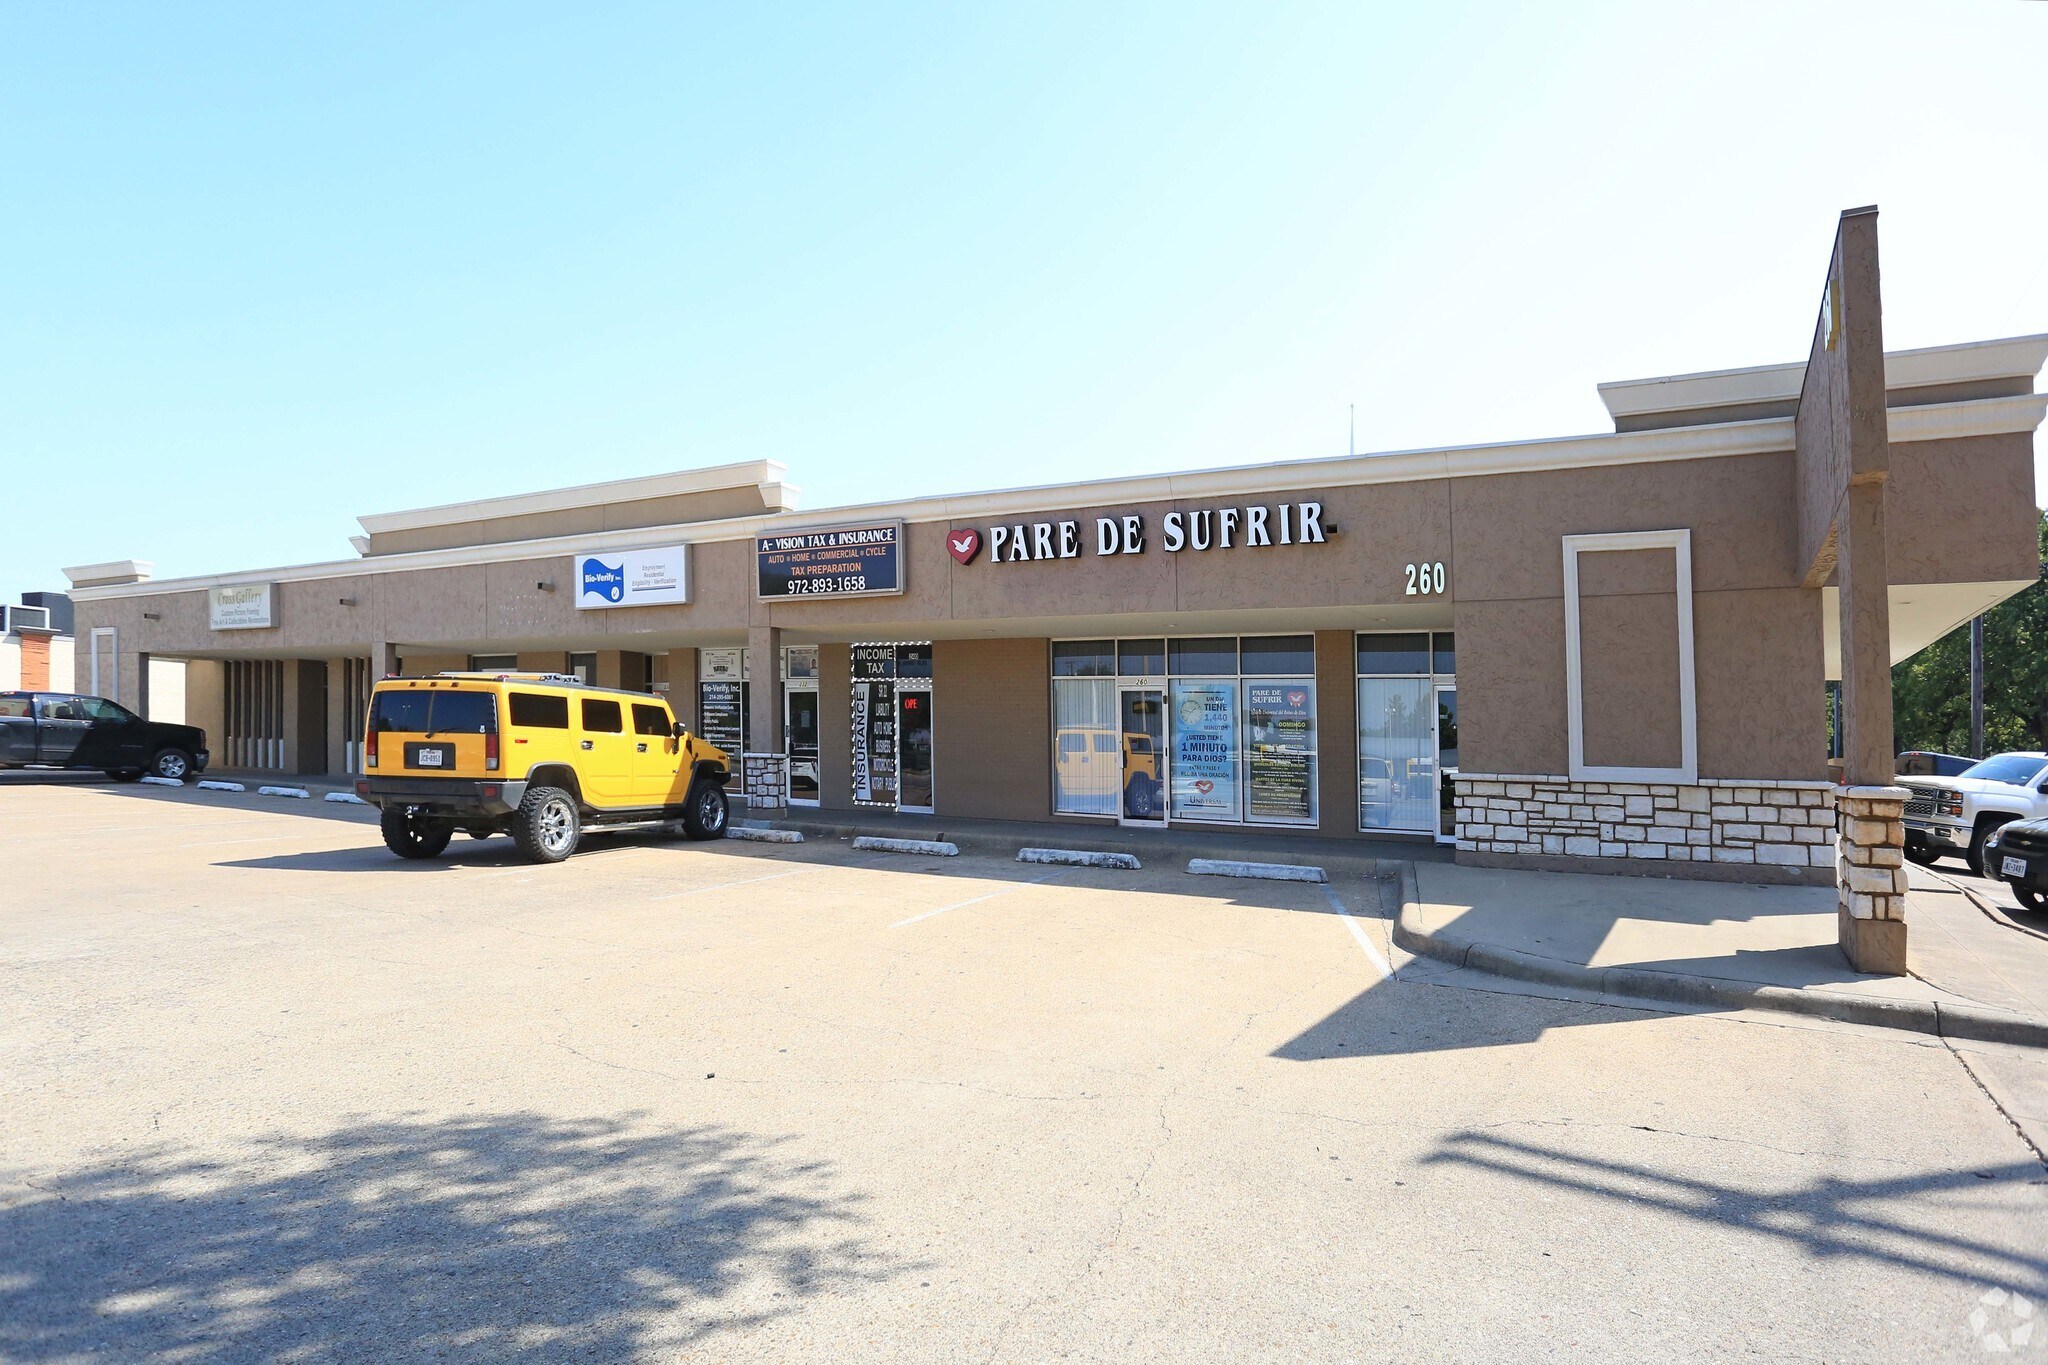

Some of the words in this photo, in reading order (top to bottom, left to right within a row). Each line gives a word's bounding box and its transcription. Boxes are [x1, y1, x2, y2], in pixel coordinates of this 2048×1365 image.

[990, 520, 1080, 563] PARE
[1097, 515, 1144, 557] DE
[1163, 502, 1326, 552] SUFRIR
[775, 537, 805, 550] VISION
[807, 535, 826, 547] TAX
[829, 534, 836, 546] &
[839, 529, 893, 544] INSURANCE
[768, 556, 784, 564] AUTO
[792, 553, 810, 562] HOME
[817, 550, 859, 560] COMMERCIAL
[865, 547, 886, 556] CYCLE
[791, 566, 805, 576] TAX
[807, 562, 862, 575] PREPARATION
[585, 572, 614, 583] Bio-Verify
[1405, 562, 1445, 595] 260
[788, 575, 866, 594] 972-893-1658
[856, 648, 893, 660] INCOME
[867, 662, 885, 674] TAX
[1252, 696, 1282, 704] SUFRIR
[1204, 703, 1228, 711] TIENE
[1204, 714, 1228, 722] 1,440
[856, 691, 866, 790] INSURANCE
[1182, 743, 1188, 752] 1
[1190, 743, 1228, 752] MINUTO
[1182, 754, 1202, 762] PARA
[1204, 754, 1227, 763] DIOS?
